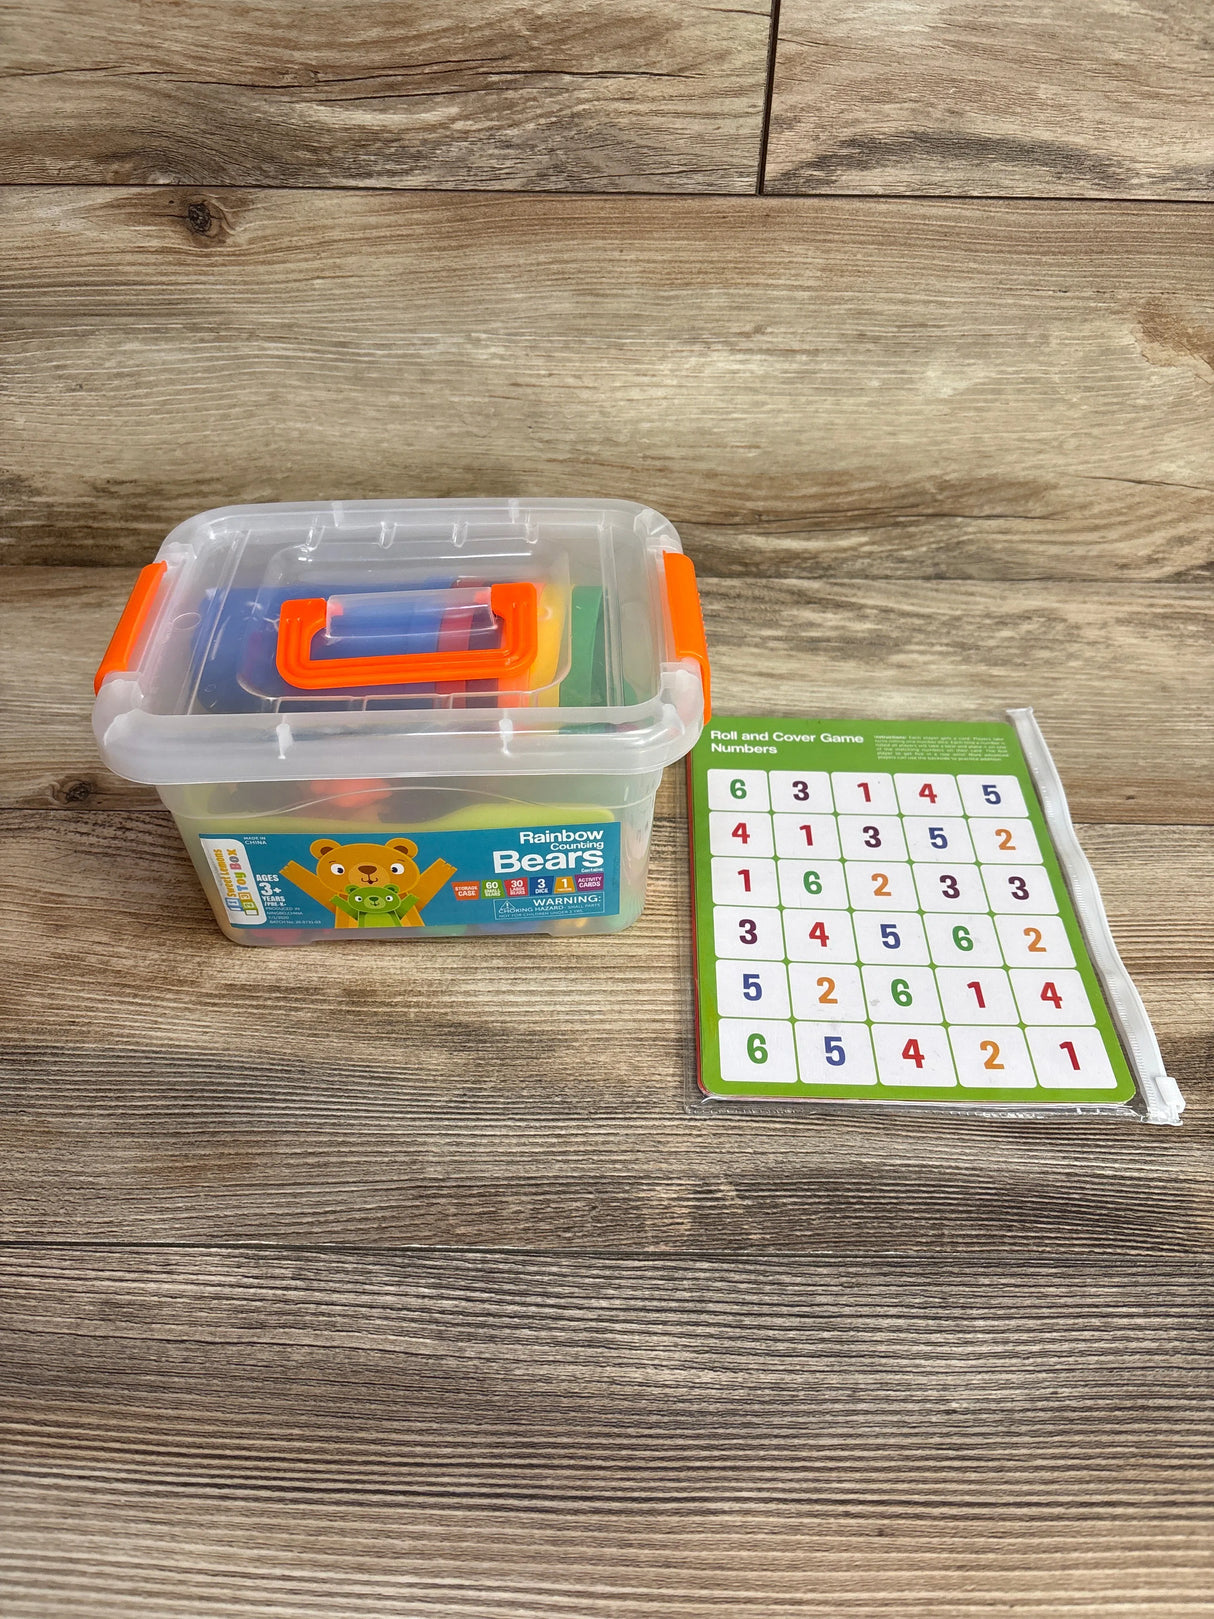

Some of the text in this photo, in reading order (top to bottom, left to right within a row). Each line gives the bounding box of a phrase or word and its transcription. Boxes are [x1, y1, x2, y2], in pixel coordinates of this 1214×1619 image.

[710, 730, 864, 744] Roll and Cover Game
[711, 743, 778, 754] Numbers
[731, 780, 1001, 804] 6 3 1 4 5
[519, 829, 604, 844] Rainbow
[732, 823, 1016, 850] 4 1 3 5 2
[550, 841, 604, 851] Counting
[492, 849, 604, 874] Bears
[213, 849, 237, 898] Sweet Lemons
[226, 848, 249, 892] Toy Box
[256, 874, 280, 882] AGES
[485, 881, 499, 889] 60
[510, 880, 523, 888] 30
[537, 878, 546, 888] 3
[561, 878, 568, 888] 1
[738, 869, 1029, 900] 1 6 2 3 3
[259, 882, 282, 896] 3+
[533, 894, 601, 906] WARNING:
[739, 919, 1046, 952] 3 4 5 6 2
[743, 974, 1063, 1009] 5 2 6 1 4
[748, 1034, 1080, 1070] 6 5 4 2 1
